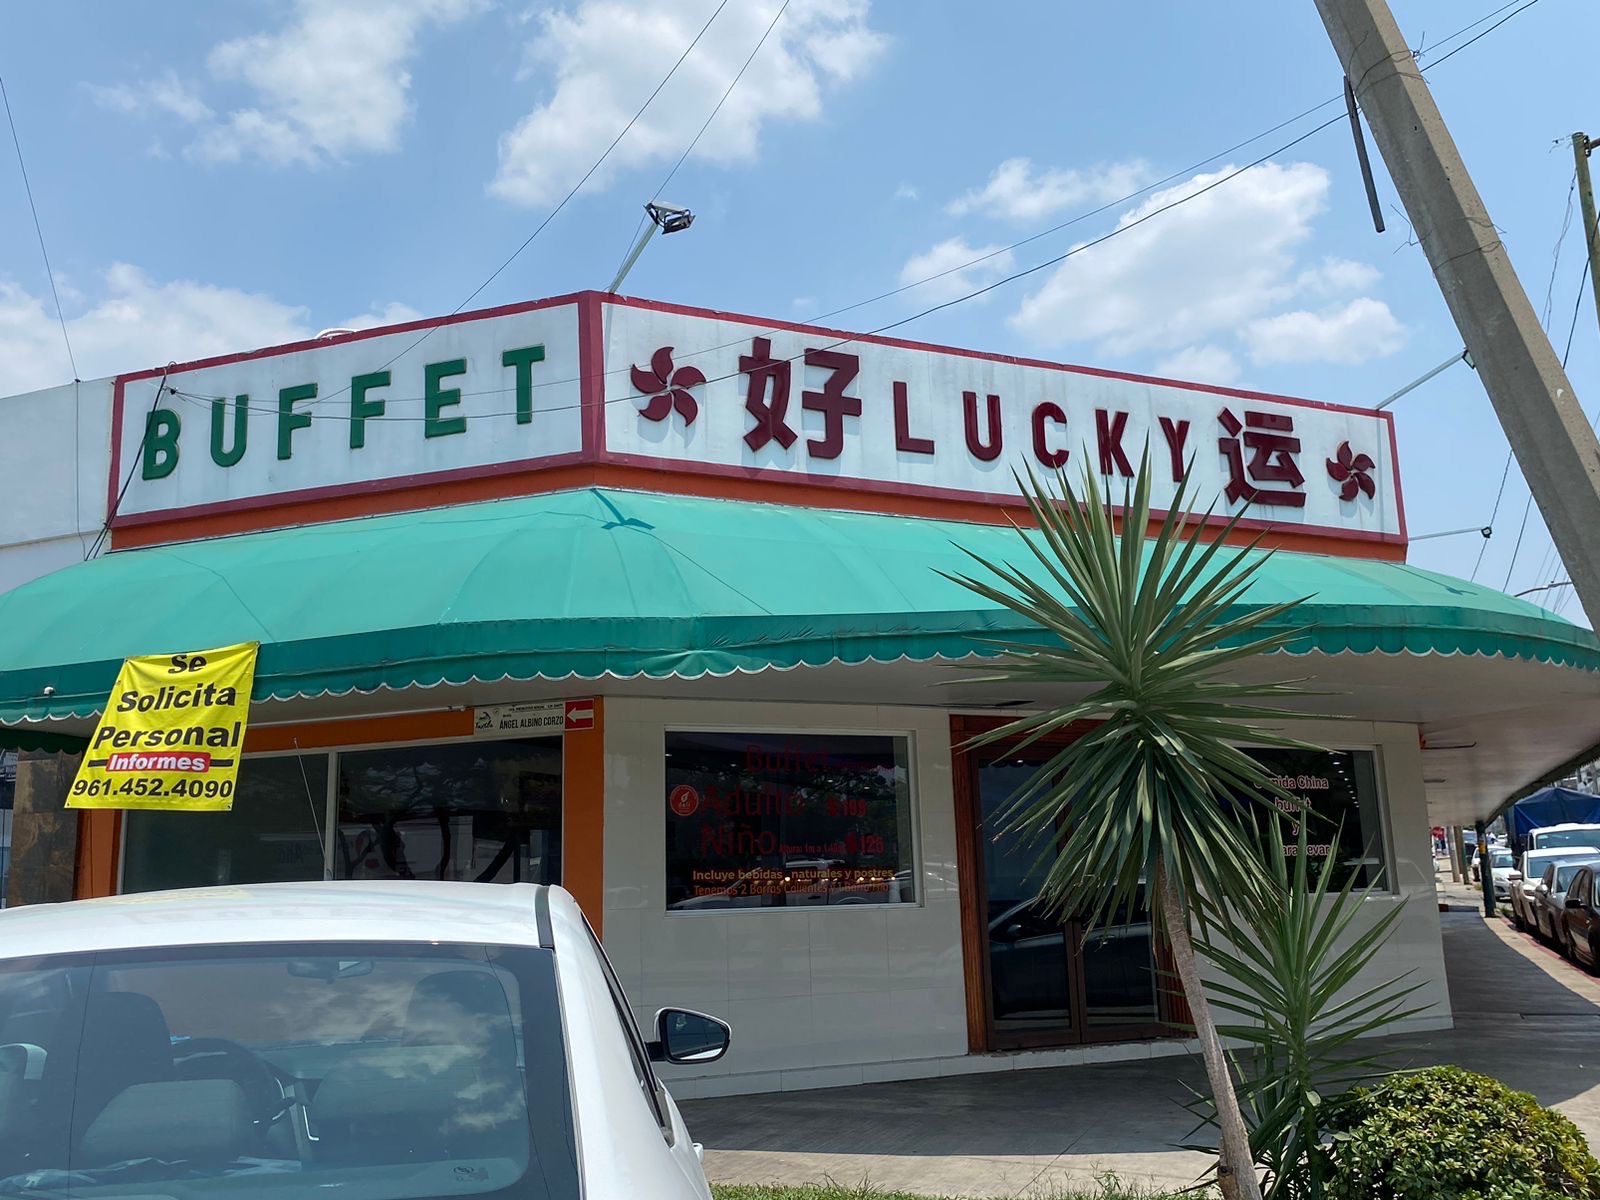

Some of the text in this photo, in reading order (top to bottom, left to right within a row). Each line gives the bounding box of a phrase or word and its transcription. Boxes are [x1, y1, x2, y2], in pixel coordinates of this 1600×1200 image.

[142, 343, 546, 480] BUFFET
[738, 336, 1307, 508] 好 LUCKY 运
[168, 653, 207, 674] Se
[116, 681, 236, 713] Solicita
[520, 718, 543, 728] ALBINO
[543, 715, 564, 727] CORZO
[92, 721, 242, 750] Personal
[109, 753, 206, 772] Informes
[745, 743, 830, 774] Buffet
[72, 778, 233, 798] 961.452.4090
[1297, 775, 1329, 789] China
[701, 784, 804, 816] Adulto
[701, 822, 777, 857] Niño
[1281, 844, 1299, 857] ara
[693, 869, 894, 882] Incluye bebidas naturales y postres
[693, 885, 738, 897] Tenemos
[741, 884, 747, 895] 2
